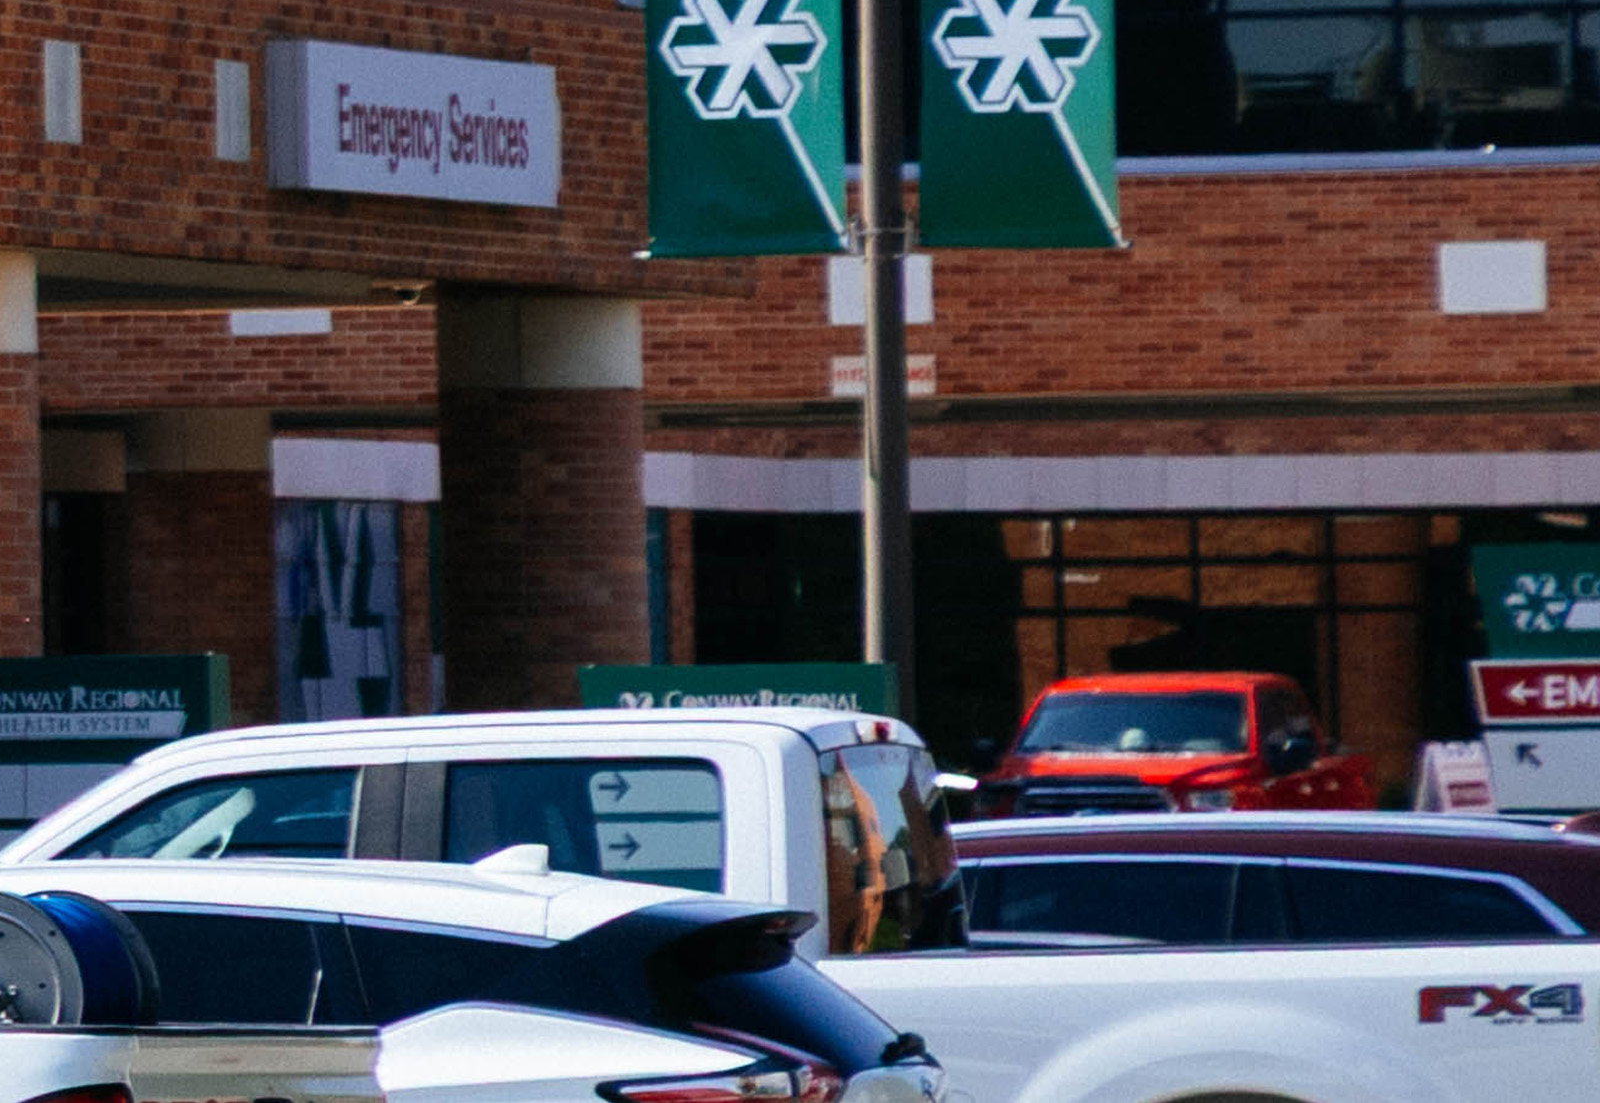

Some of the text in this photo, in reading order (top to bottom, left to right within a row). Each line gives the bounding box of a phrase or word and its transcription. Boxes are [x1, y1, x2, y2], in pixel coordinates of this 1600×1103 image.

[336, 83, 529, 174] Emergency Services
[70, 685, 186, 712] REGIONAL
[78, 715, 151, 733] SYSTEM
[1418, 983, 1584, 1024] FX4
